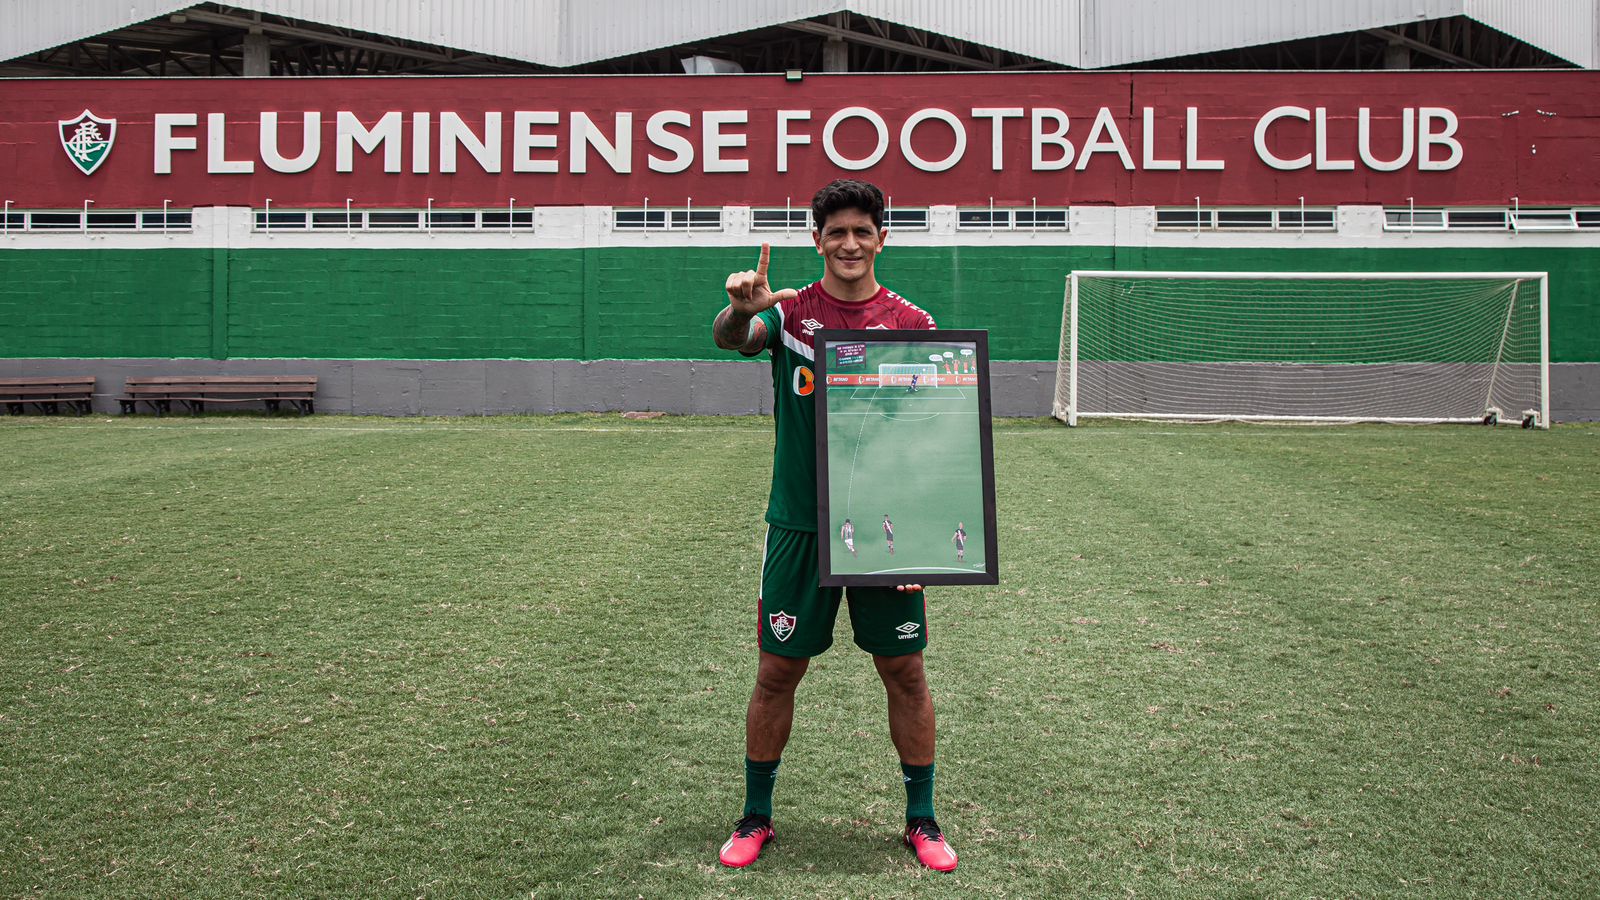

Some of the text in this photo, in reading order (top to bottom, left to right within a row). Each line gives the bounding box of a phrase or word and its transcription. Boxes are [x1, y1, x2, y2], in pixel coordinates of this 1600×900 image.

[153, 105, 1464, 174] FLUMINENSE FOOTBALL CLUB
[897, 632, 919, 640] umbro
